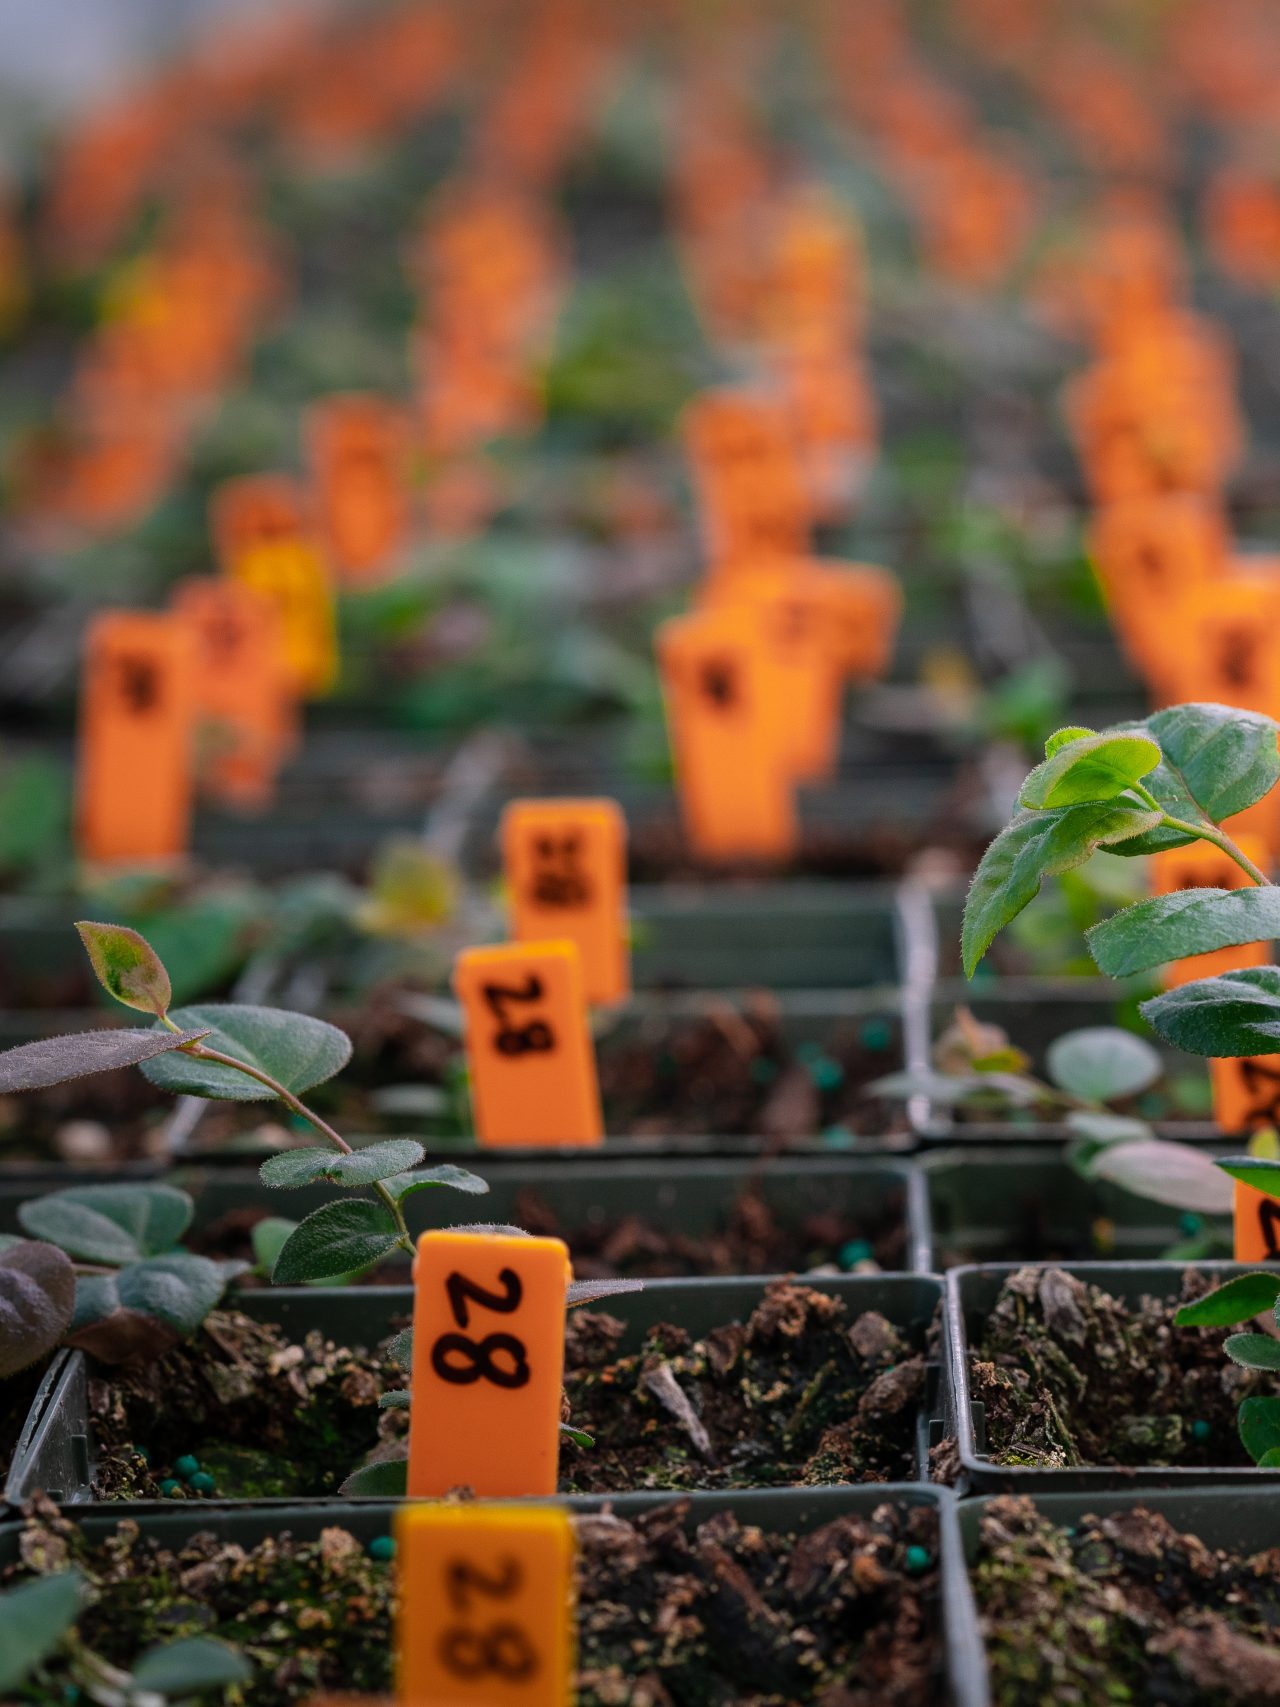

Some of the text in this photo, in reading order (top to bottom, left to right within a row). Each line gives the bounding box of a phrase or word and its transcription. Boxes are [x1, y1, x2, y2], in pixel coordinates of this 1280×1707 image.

[480, 972, 557, 1060] 28
[430, 1267, 531, 1390] 28
[437, 1554, 541, 1686] 28
